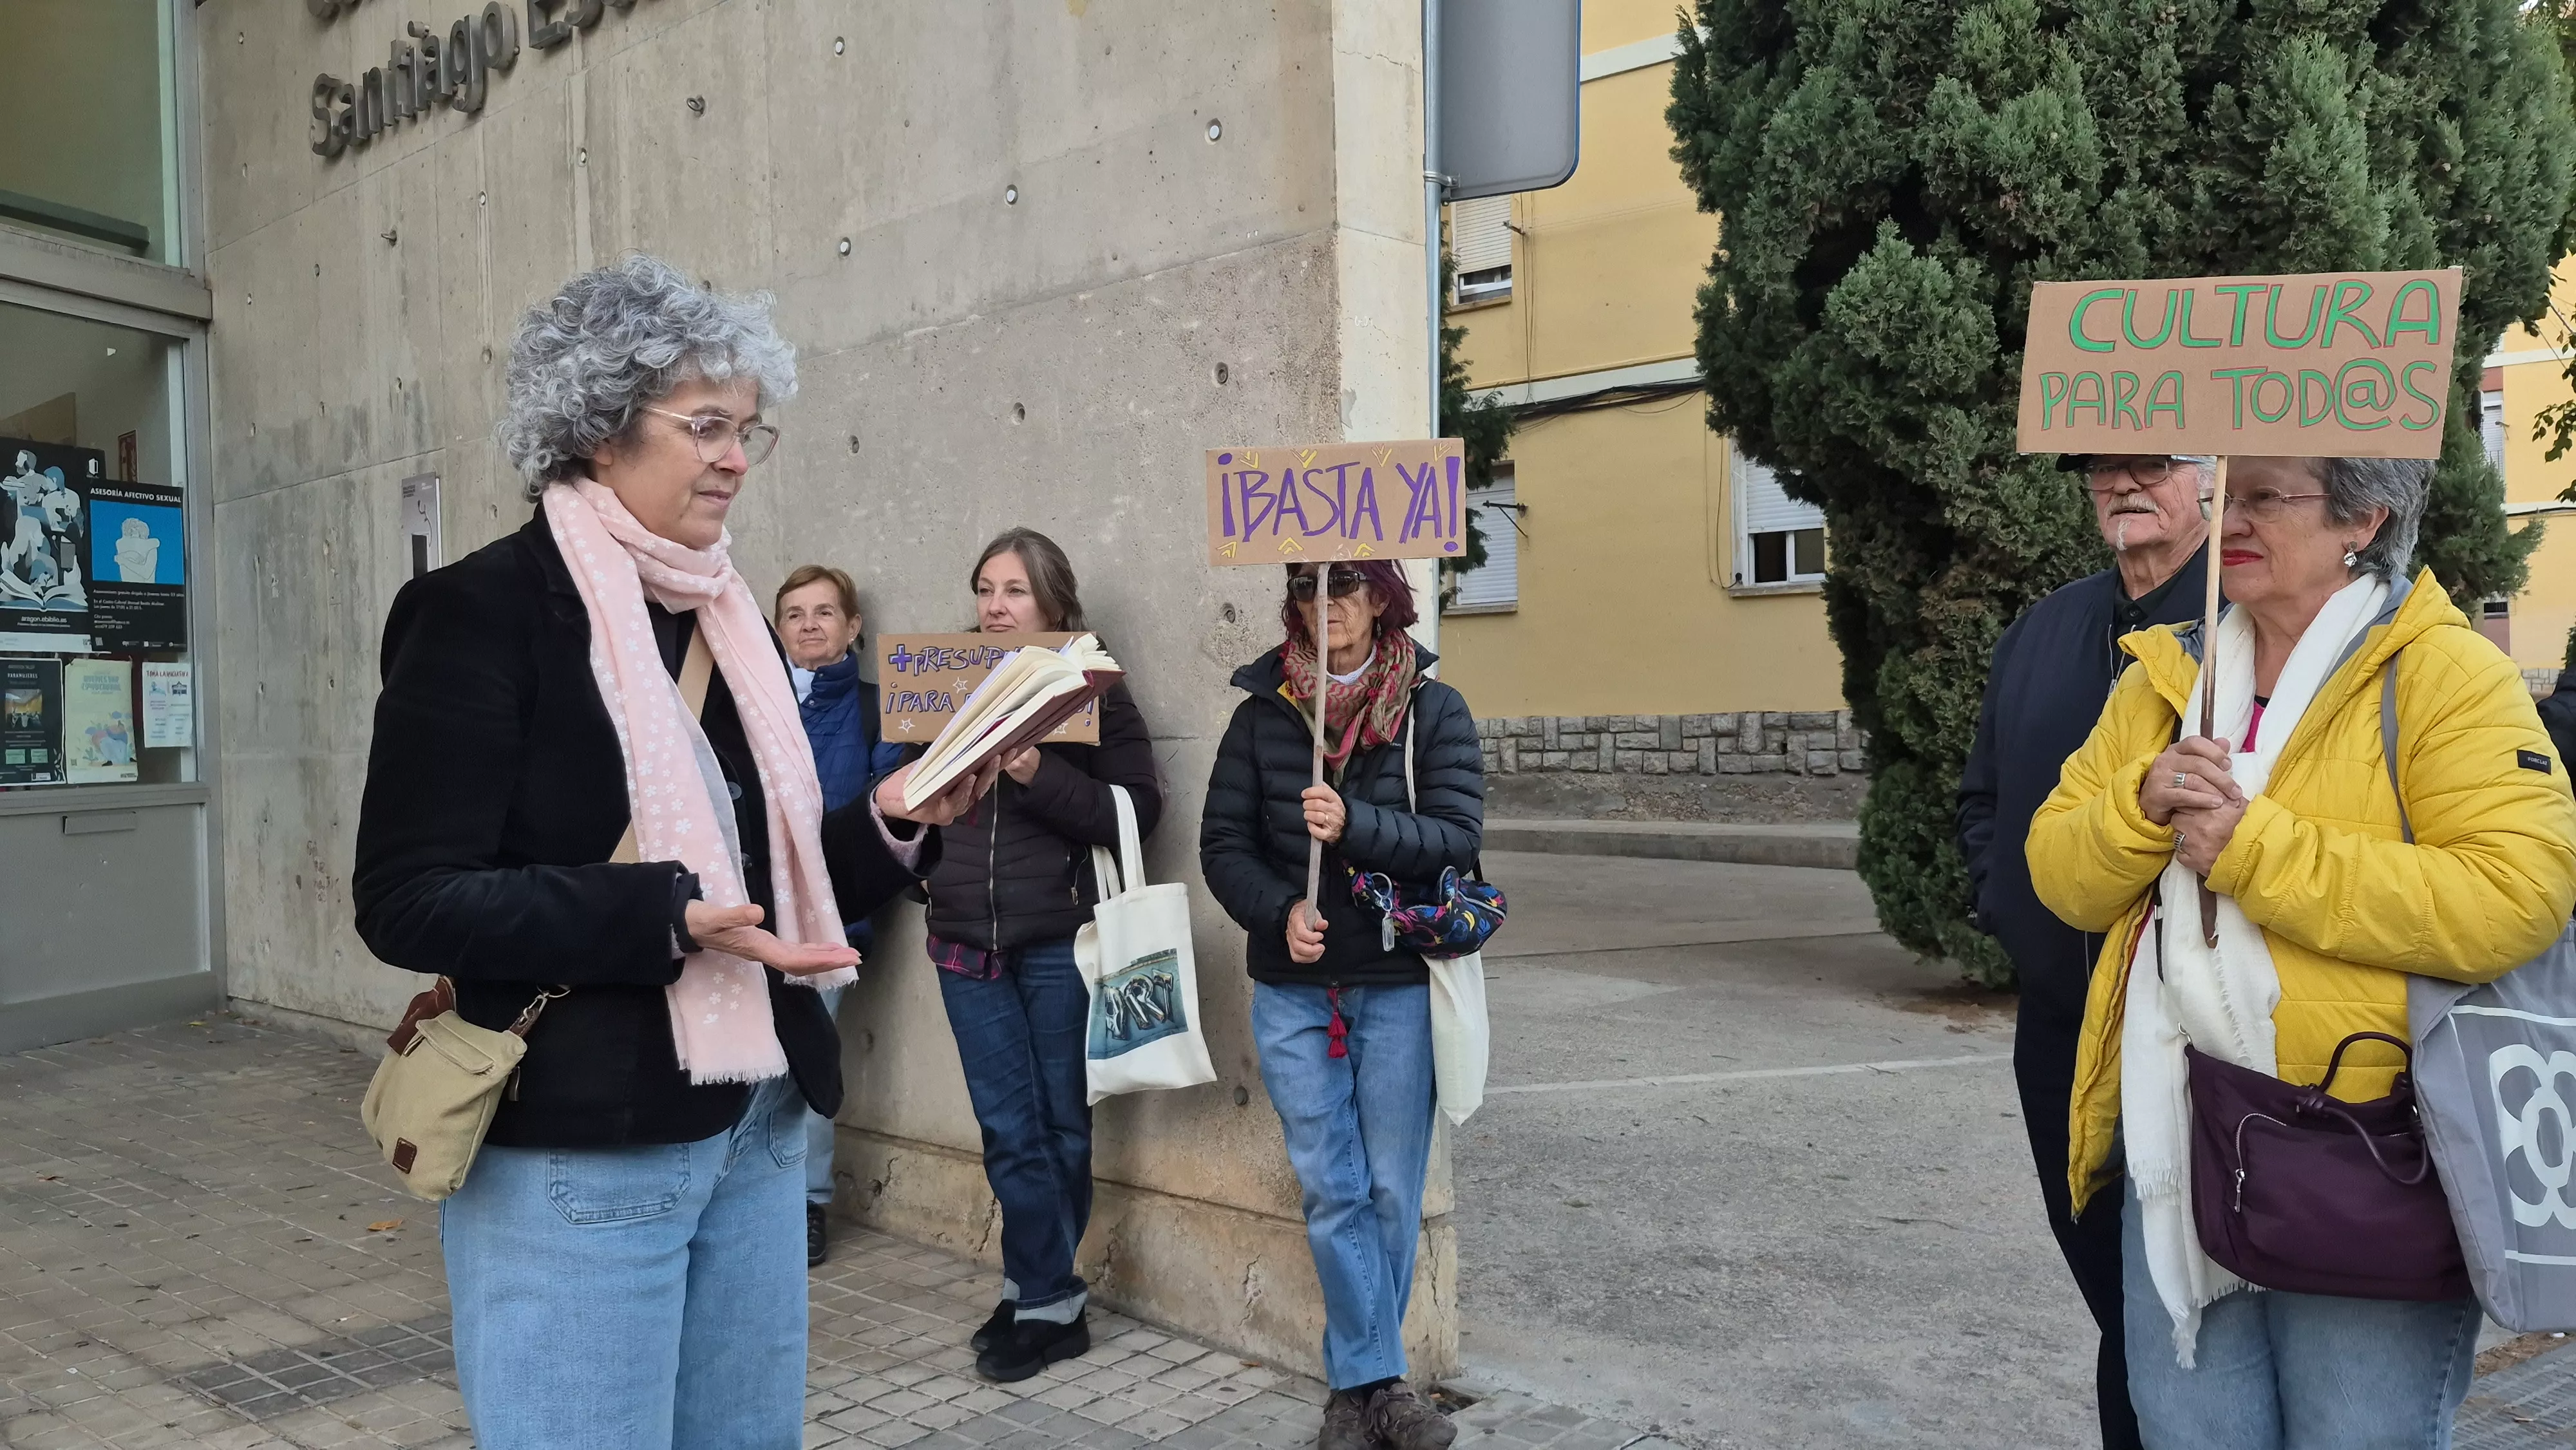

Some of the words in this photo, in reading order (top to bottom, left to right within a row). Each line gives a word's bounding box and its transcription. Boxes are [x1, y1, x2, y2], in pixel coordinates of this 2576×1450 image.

[310, 1, 517, 157] Santiago
[2069, 278, 2442, 353] CULTURA
[2038, 369, 2186, 431] PARA
[2210, 358, 2441, 431] TOD@S
[90, 487, 123, 497] ASESORÍA
[124, 491, 155, 500] AFECTIVO
[156, 494, 182, 503] SEXUAL
[1217, 453, 1384, 543] ¡BASTA
[1395, 456, 1461, 552] YA!
[888, 644, 1065, 676] +PRESUP
[886, 683, 956, 713] ¡PARA
[2527, 757, 2548, 766] FORCLAZ
